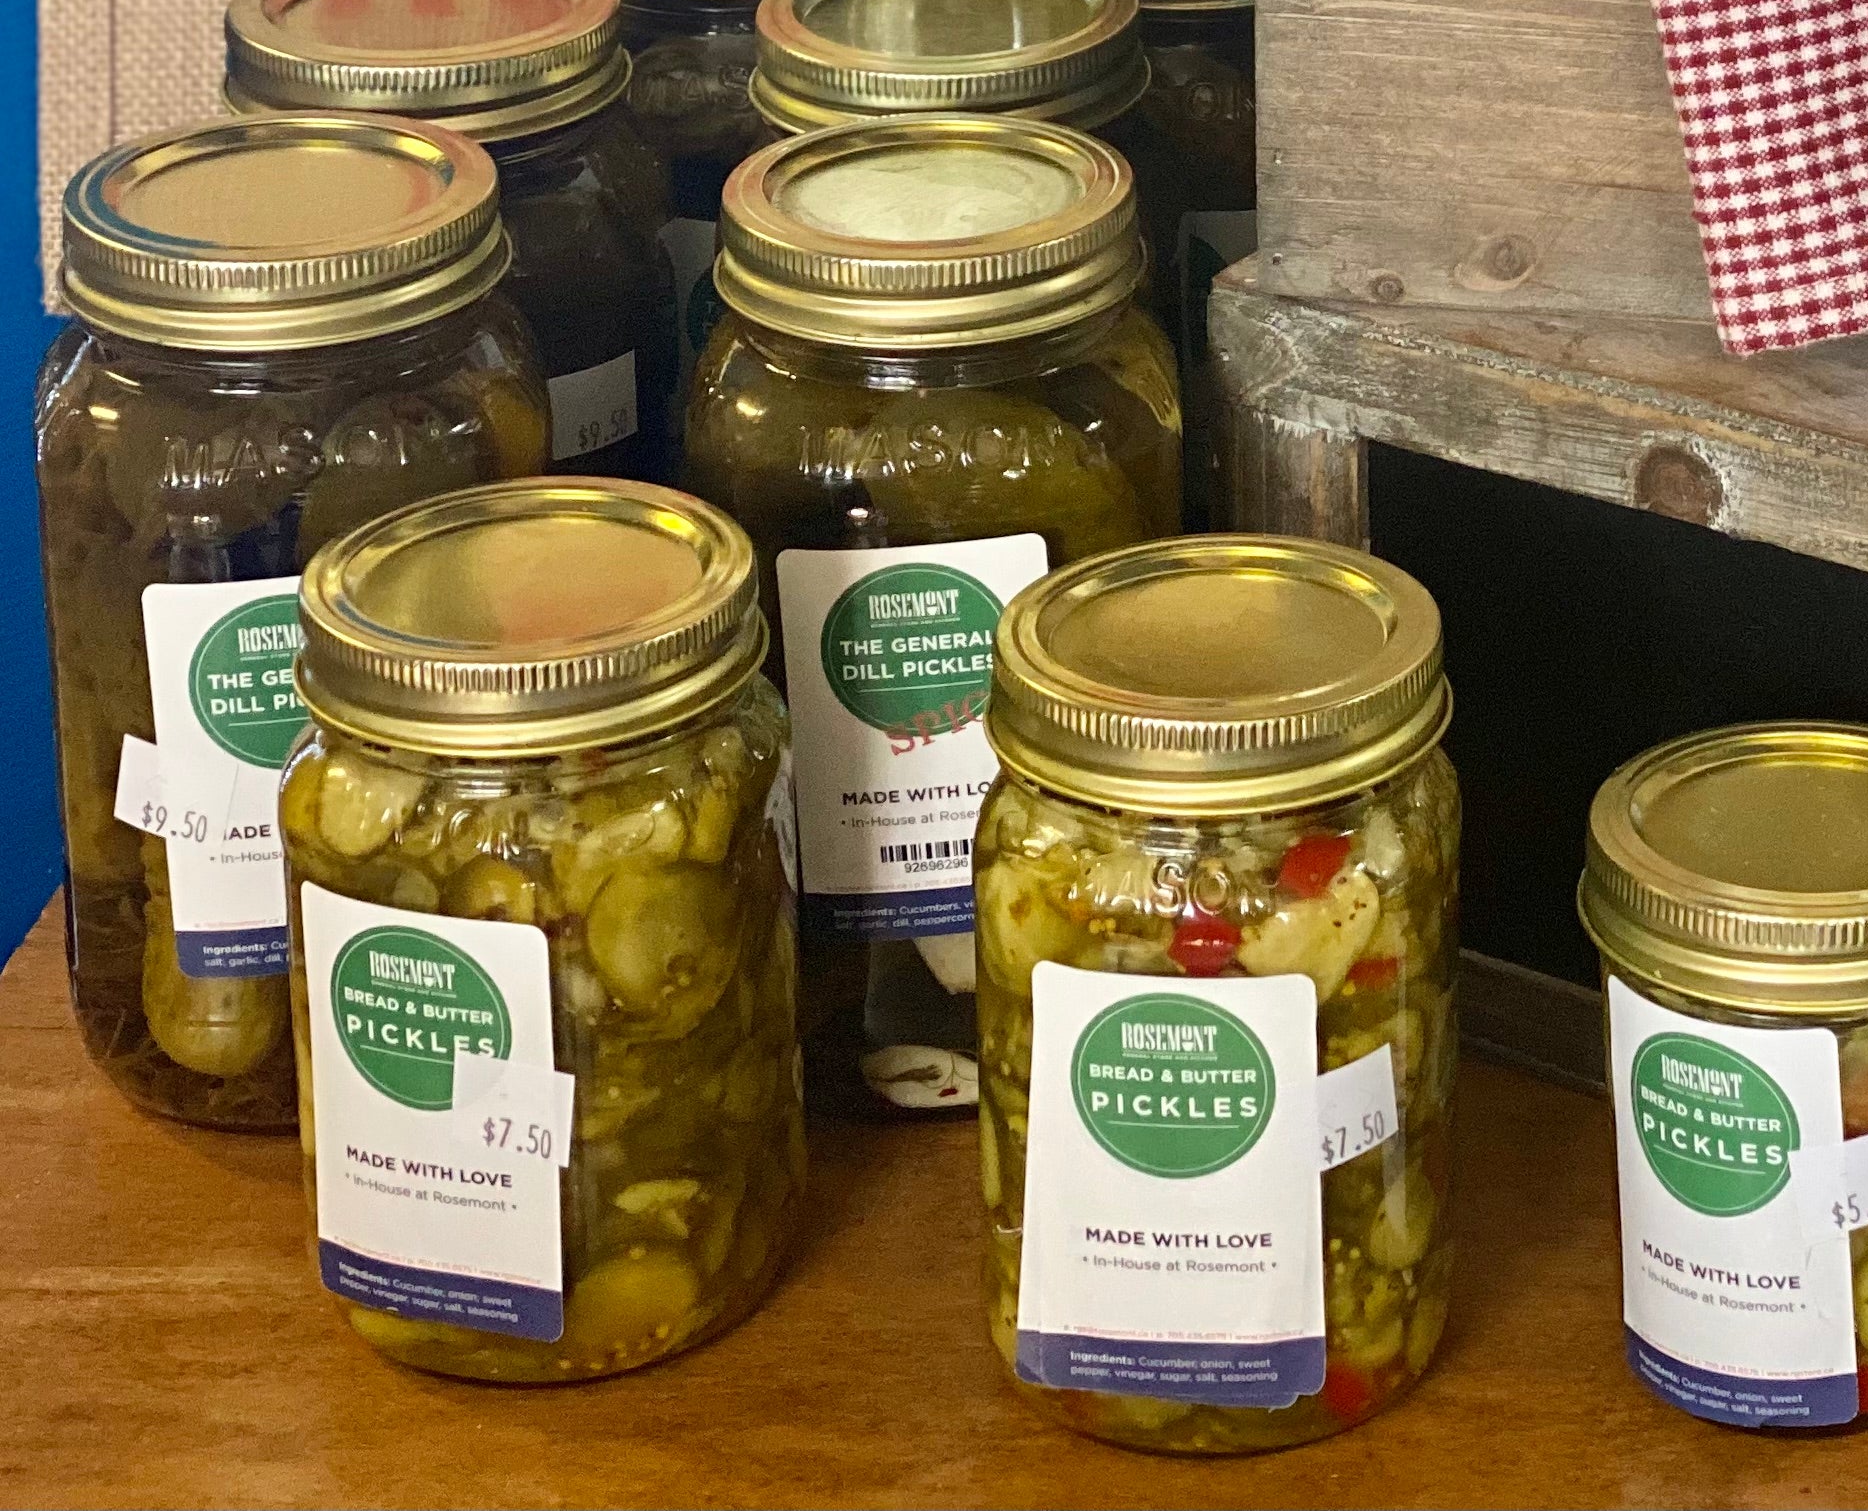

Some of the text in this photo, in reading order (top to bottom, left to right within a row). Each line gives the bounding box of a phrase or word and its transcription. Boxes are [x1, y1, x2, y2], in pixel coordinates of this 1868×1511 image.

[869, 590, 959, 620] ROSEMONT
[238, 624, 299, 654] ROSEM
[840, 630, 993, 656] THE GENERAL
[207, 673, 253, 689] THE
[843, 664, 895, 680] DILL
[211, 698, 265, 715] DILL
[886, 690, 989, 756] SPIC
[843, 782, 990, 805] MADE WITH LO
[143, 801, 207, 843] $9.50
[852, 813, 934, 827] In-House at
[369, 950, 455, 990] ROSEMONT
[345, 987, 399, 1011] BREAD
[405, 1001, 416, 1015] &
[423, 1005, 493, 1024] BUTTER
[1121, 1021, 1217, 1053] ROSEMONT
[1089, 1064, 1256, 1084] BREAD & BUTTER
[1661, 1054, 1743, 1100] ROSEMONT
[1092, 1093, 1257, 1119] PICKLES
[1641, 1086, 1687, 1117] BREAD
[1694, 1108, 1705, 1121] &
[1711, 1111, 1781, 1133] BUTTER
[483, 1117, 551, 1159] $7.50
[1322, 1111, 1385, 1164] $7.50
[1644, 1113, 1783, 1165] PICKLES
[347, 1145, 512, 1187] MADE WITH LOVE
[1086, 1227, 1272, 1248] MADE WITH LOVE
[1093, 1255, 1265, 1273] In-House at Rosemont
[1642, 1240, 1801, 1290] MADE WITH LOVE
